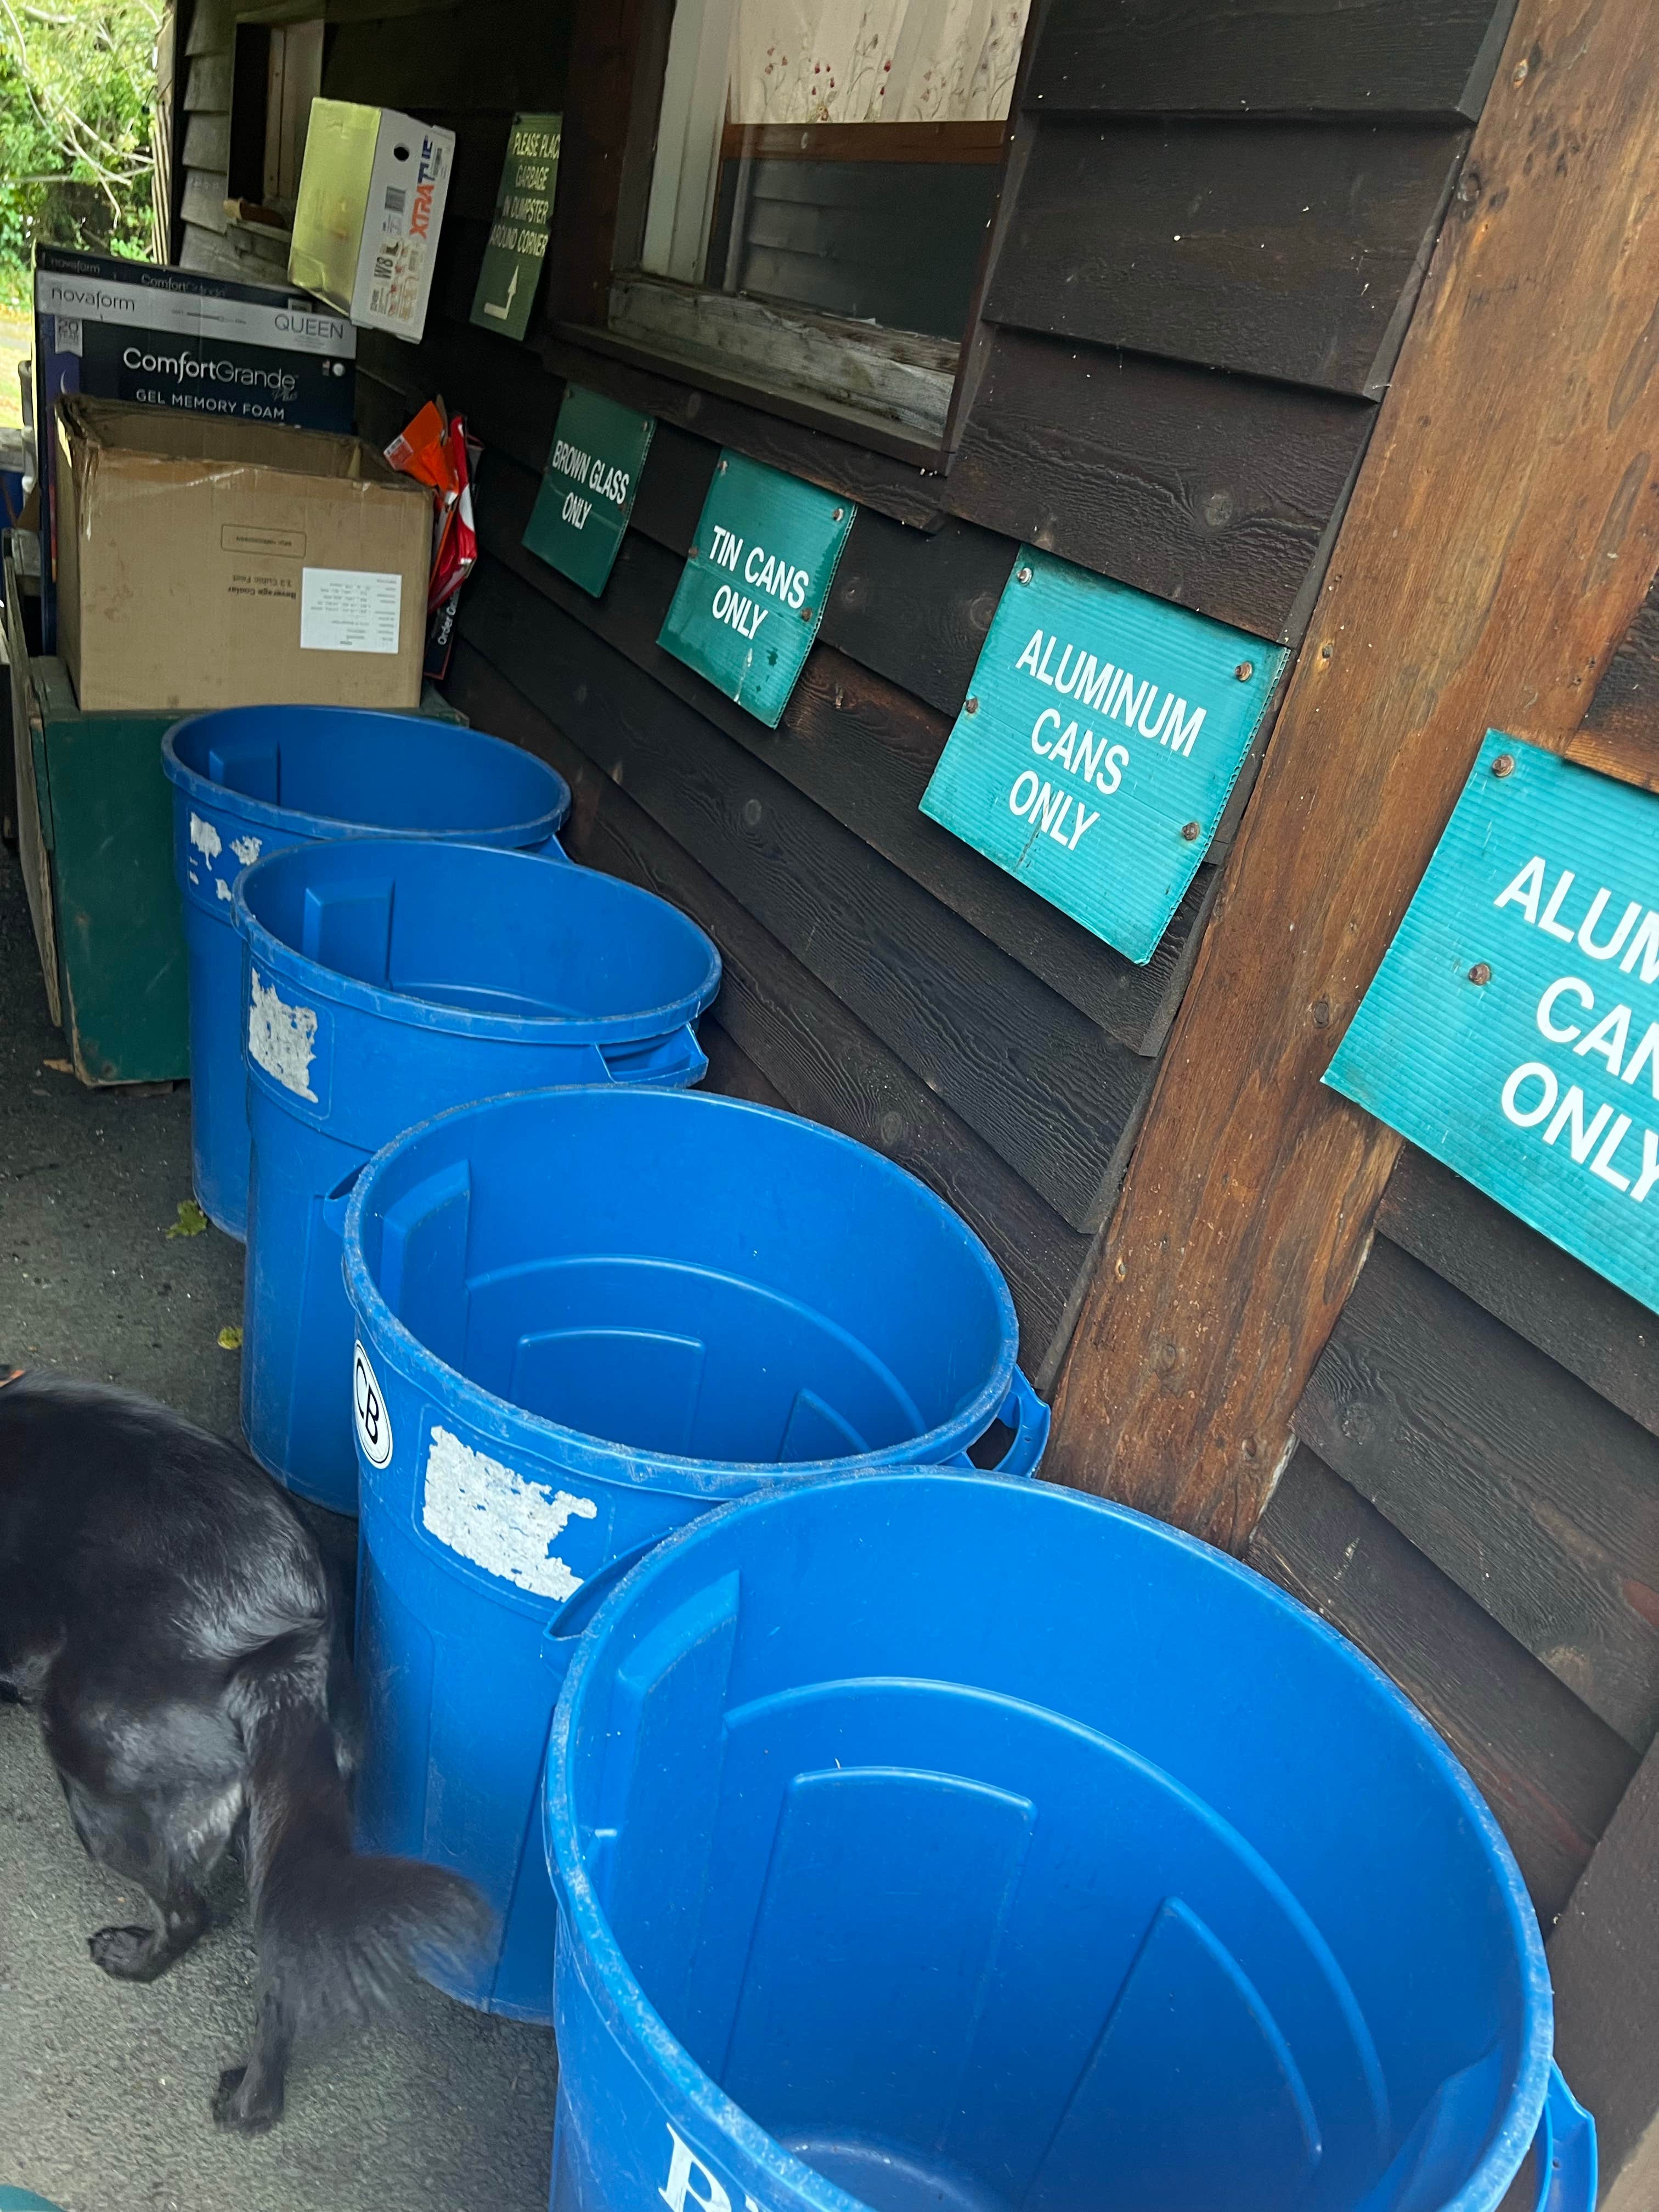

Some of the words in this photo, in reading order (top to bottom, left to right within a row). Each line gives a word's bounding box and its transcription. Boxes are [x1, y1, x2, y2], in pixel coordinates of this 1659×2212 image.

[513, 132, 541, 157] PLEASE
[515, 165, 549, 191] GARBAGE
[502, 195, 510, 217] IN
[510, 196, 549, 224] DUMPSTER
[488, 224, 518, 250] AROUND
[517, 228, 549, 258] CORNER
[52, 286, 136, 312] novaform
[274, 313, 344, 340] QUEEN
[123, 347, 296, 391] ComfortGrande
[136, 388, 166, 405] GEL
[172, 392, 237, 414] MEMORY
[242, 402, 285, 420] FOAM
[552, 440, 591, 483] BROWN
[589, 460, 630, 504] GLASS
[562, 492, 592, 530] ONLY
[709, 526, 743, 572] TIN
[744, 547, 809, 609] CANS
[712, 585, 769, 640] ONLY
[1015, 629, 1206, 757] ALUMINUM
[1030, 708, 1130, 794] CANS
[1009, 770, 1100, 851] ONLY
[1501, 1062, 1659, 1203] ONLY
